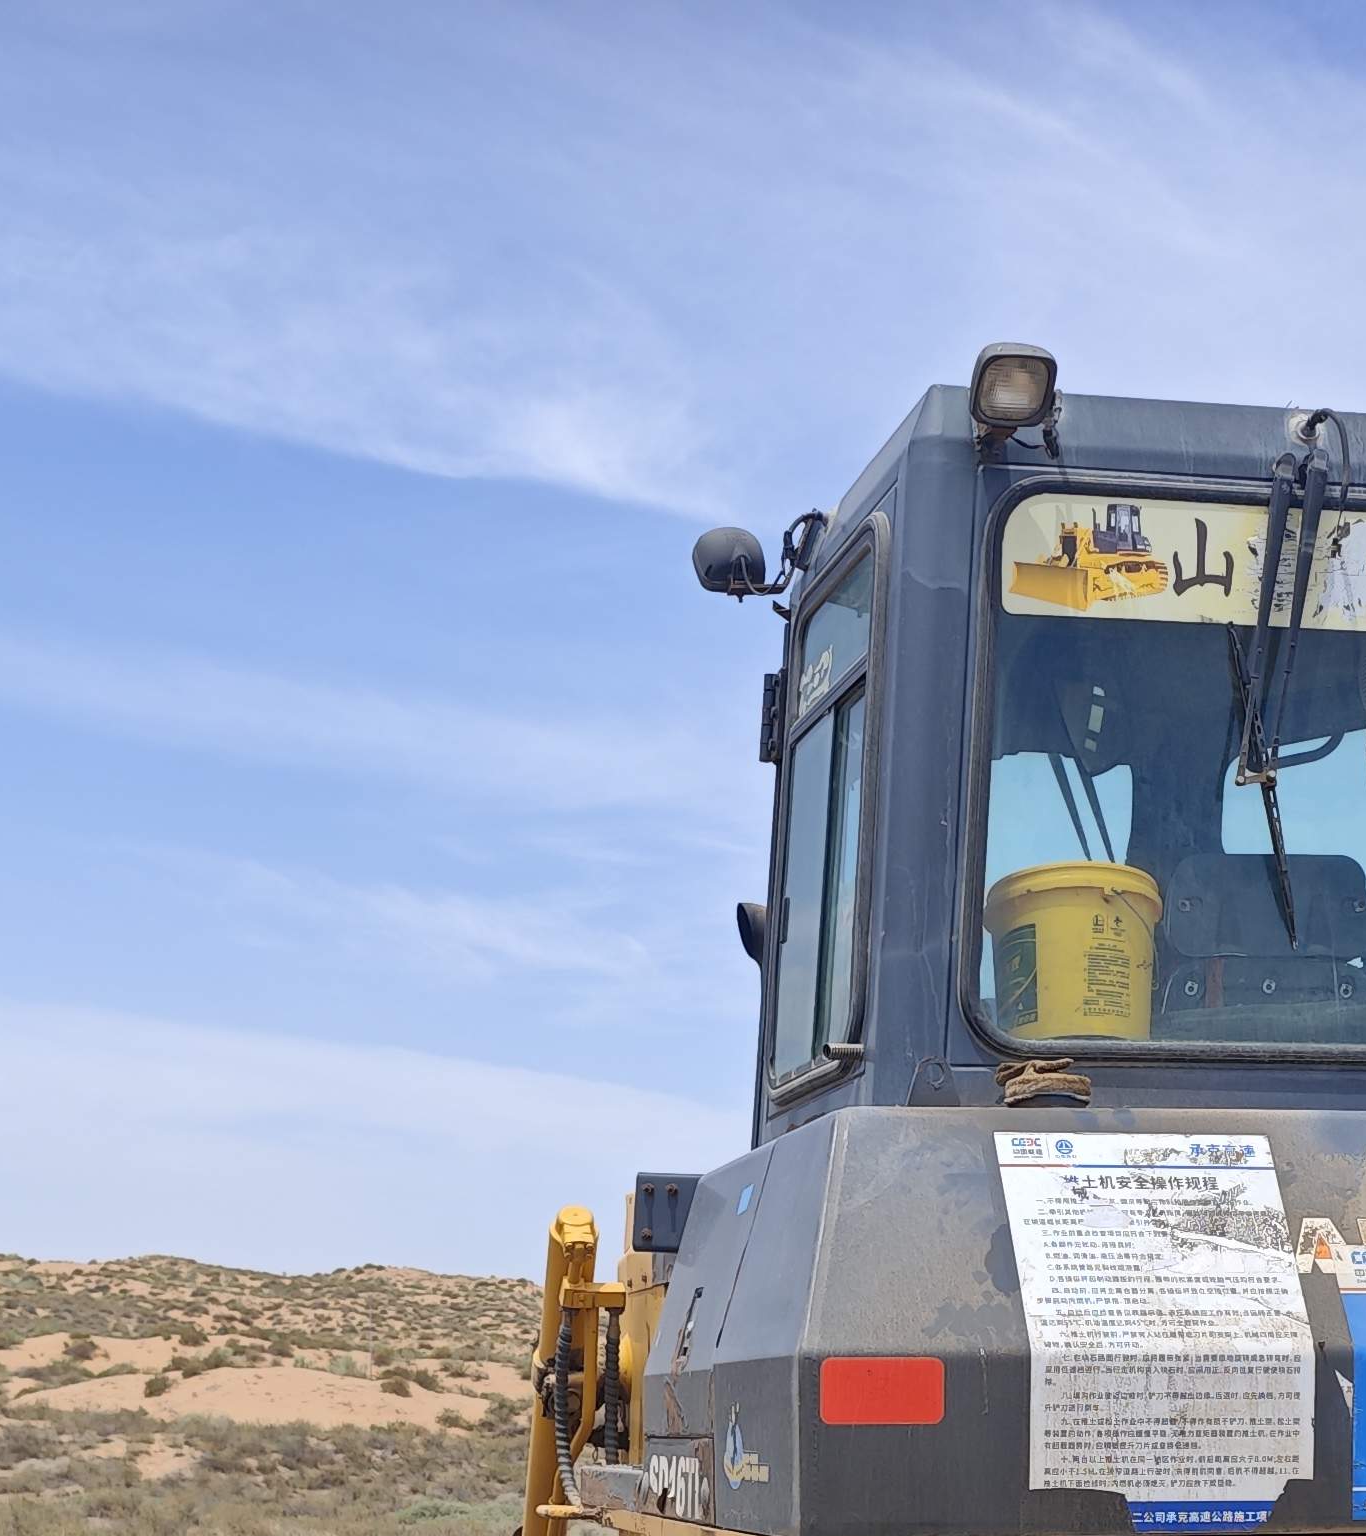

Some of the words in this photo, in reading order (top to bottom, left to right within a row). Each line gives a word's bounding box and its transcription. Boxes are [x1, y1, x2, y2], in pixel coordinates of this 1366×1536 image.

[1173, 517, 1234, 598] 山
[1132, 1510, 1272, 1523] 二公司承克高速公路施工项
